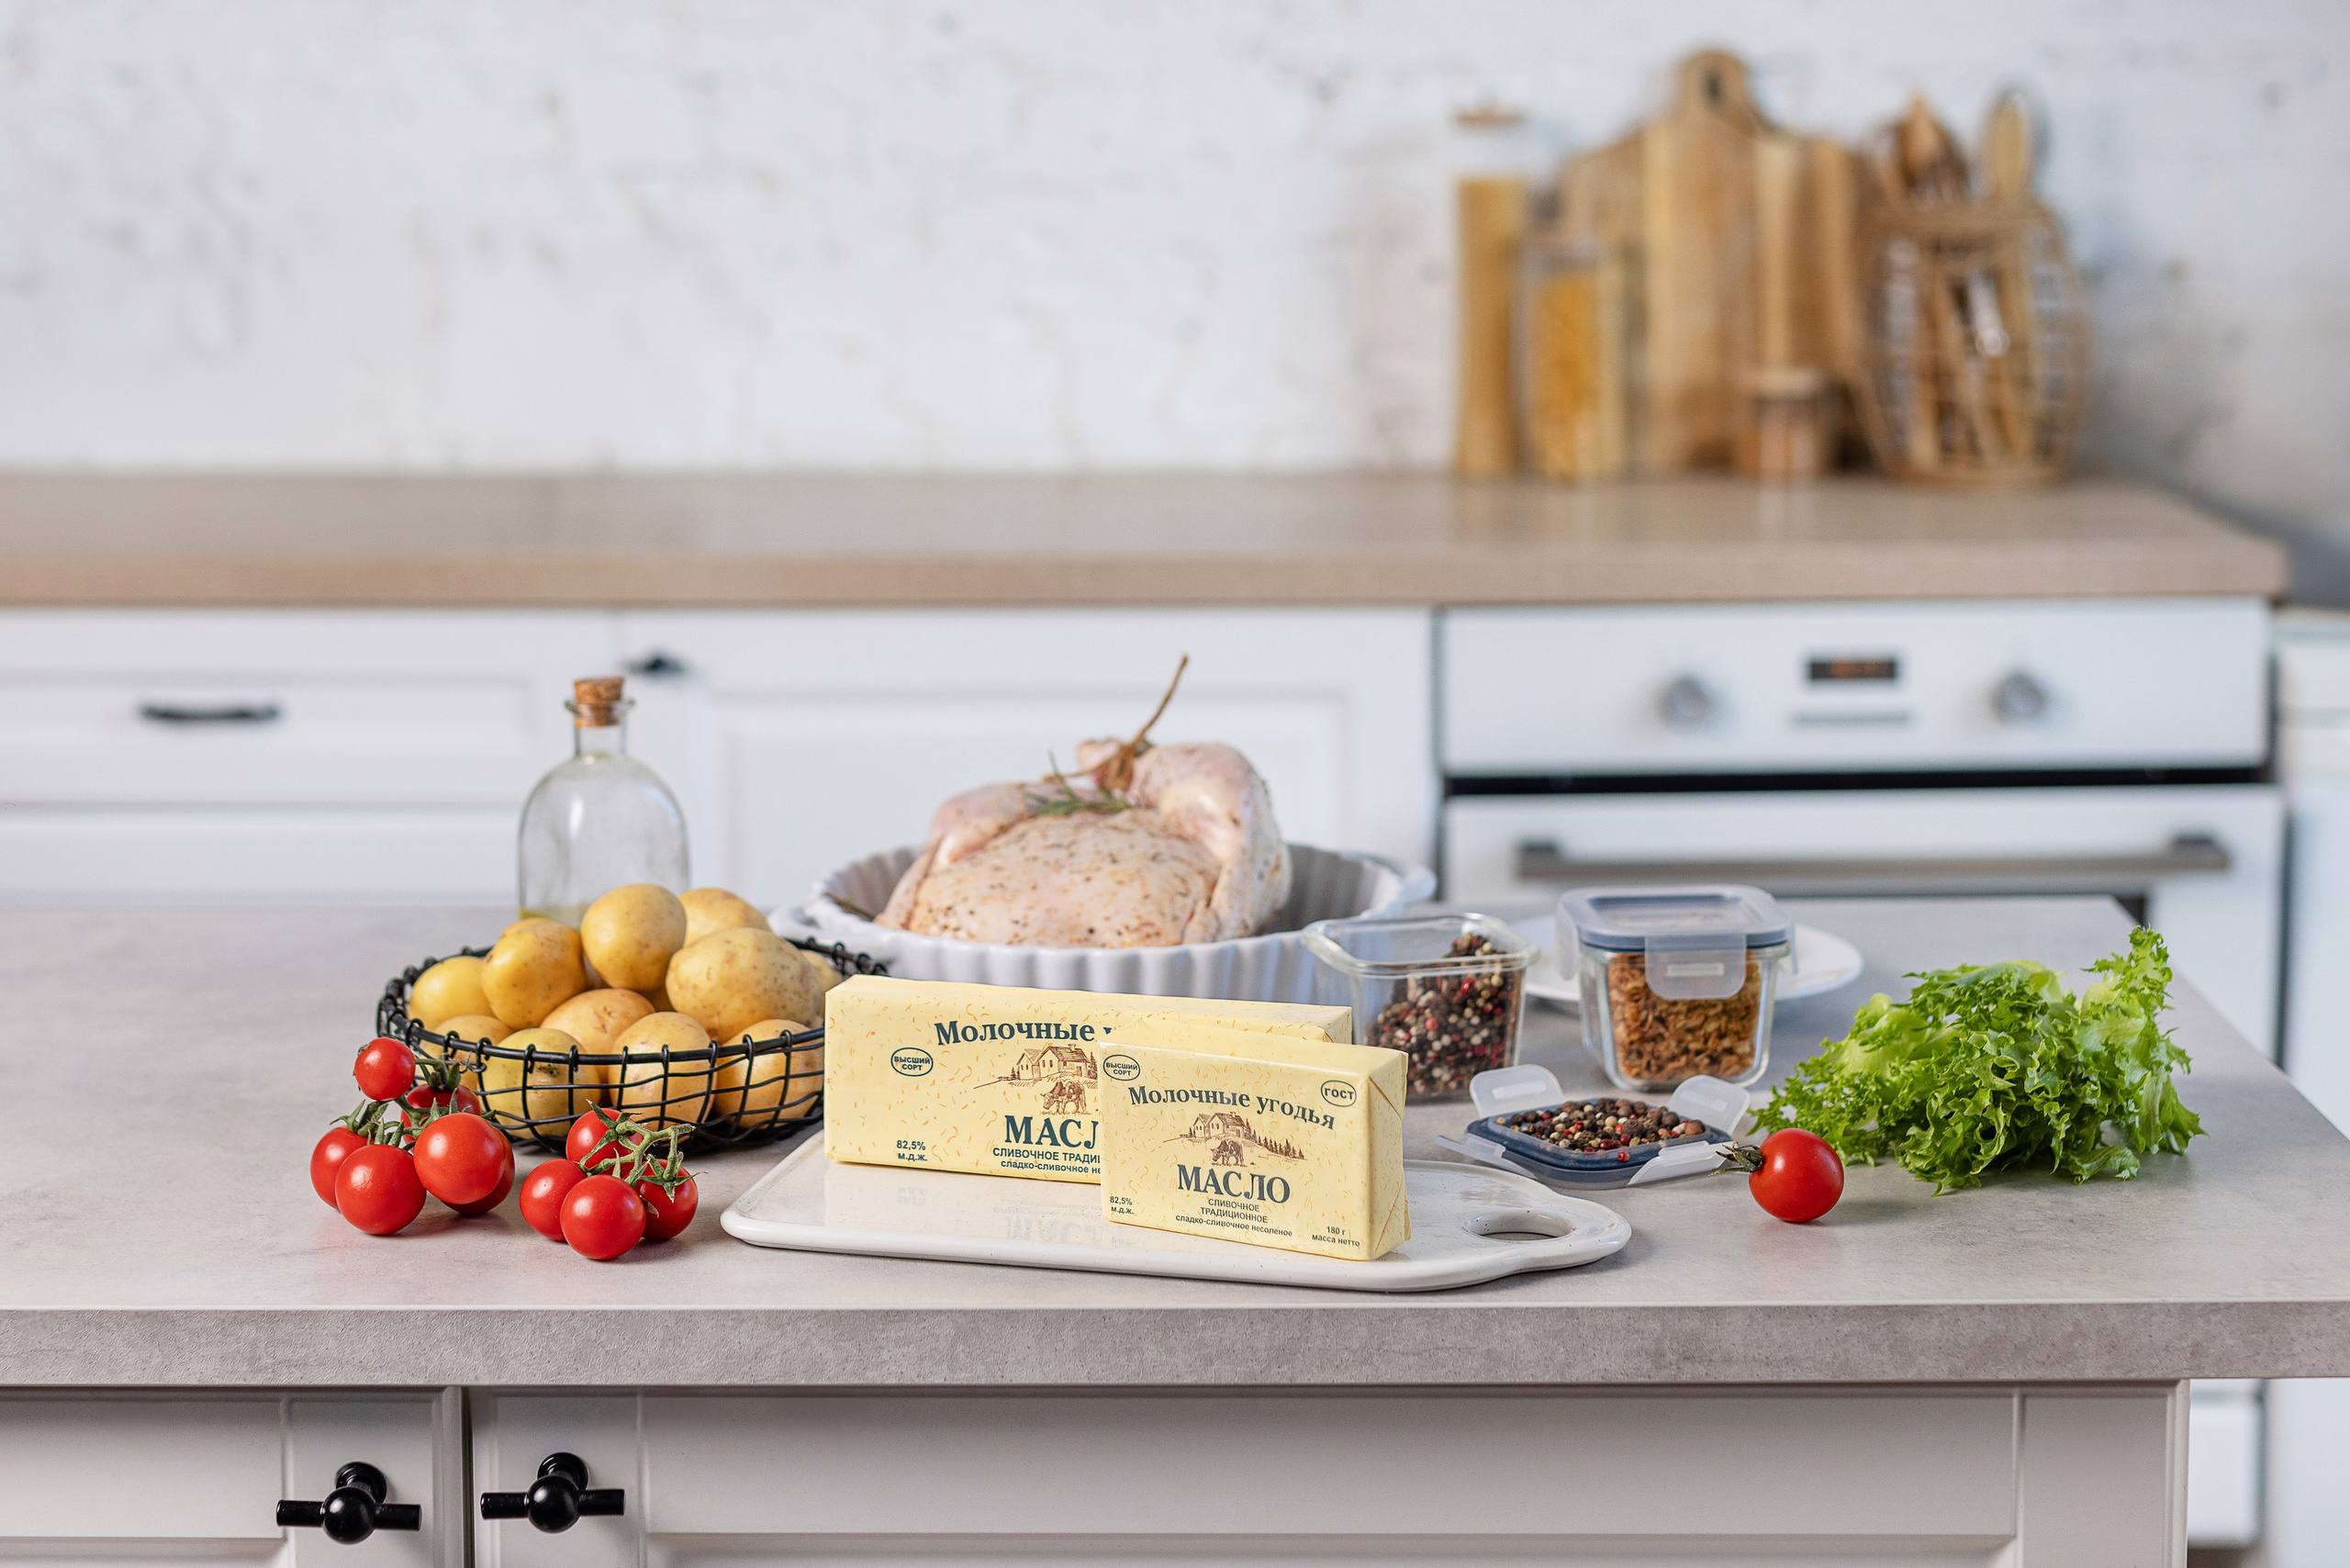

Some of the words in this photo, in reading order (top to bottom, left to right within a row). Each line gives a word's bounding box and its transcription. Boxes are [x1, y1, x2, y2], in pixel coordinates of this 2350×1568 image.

[934, 1020, 1095, 1046] Молочные
[894, 1056, 931, 1065] ВЫСШИЙ
[1105, 1061, 1138, 1070] ВЫСШИЙ
[1324, 1087, 1355, 1101] ГОСТ
[1128, 1085, 1251, 1108] Молочные
[1256, 1095, 1336, 1130] угодья
[896, 1139, 926, 1151] 82,5%
[898, 1152, 928, 1162] м.д.ж.
[992, 1148, 1059, 1161] СЛИВОЧНОЕ
[1001, 1160, 1089, 1173] сладко-сливочное
[1177, 1163, 1291, 1204] МАСЛО
[1109, 1195, 1133, 1206] 82,5%
[1208, 1198, 1260, 1212] СЛИВОЧНОЕ
[1200, 1206, 1269, 1224] ТРАДИЦИОННОЕ
[1175, 1214, 1250, 1230] сладко-сливочное
[1251, 1225, 1293, 1237] несоленое
[1326, 1226, 1340, 1235] 180
[1312, 1234, 1337, 1243] масса
[1337, 1238, 1360, 1248] нетто
